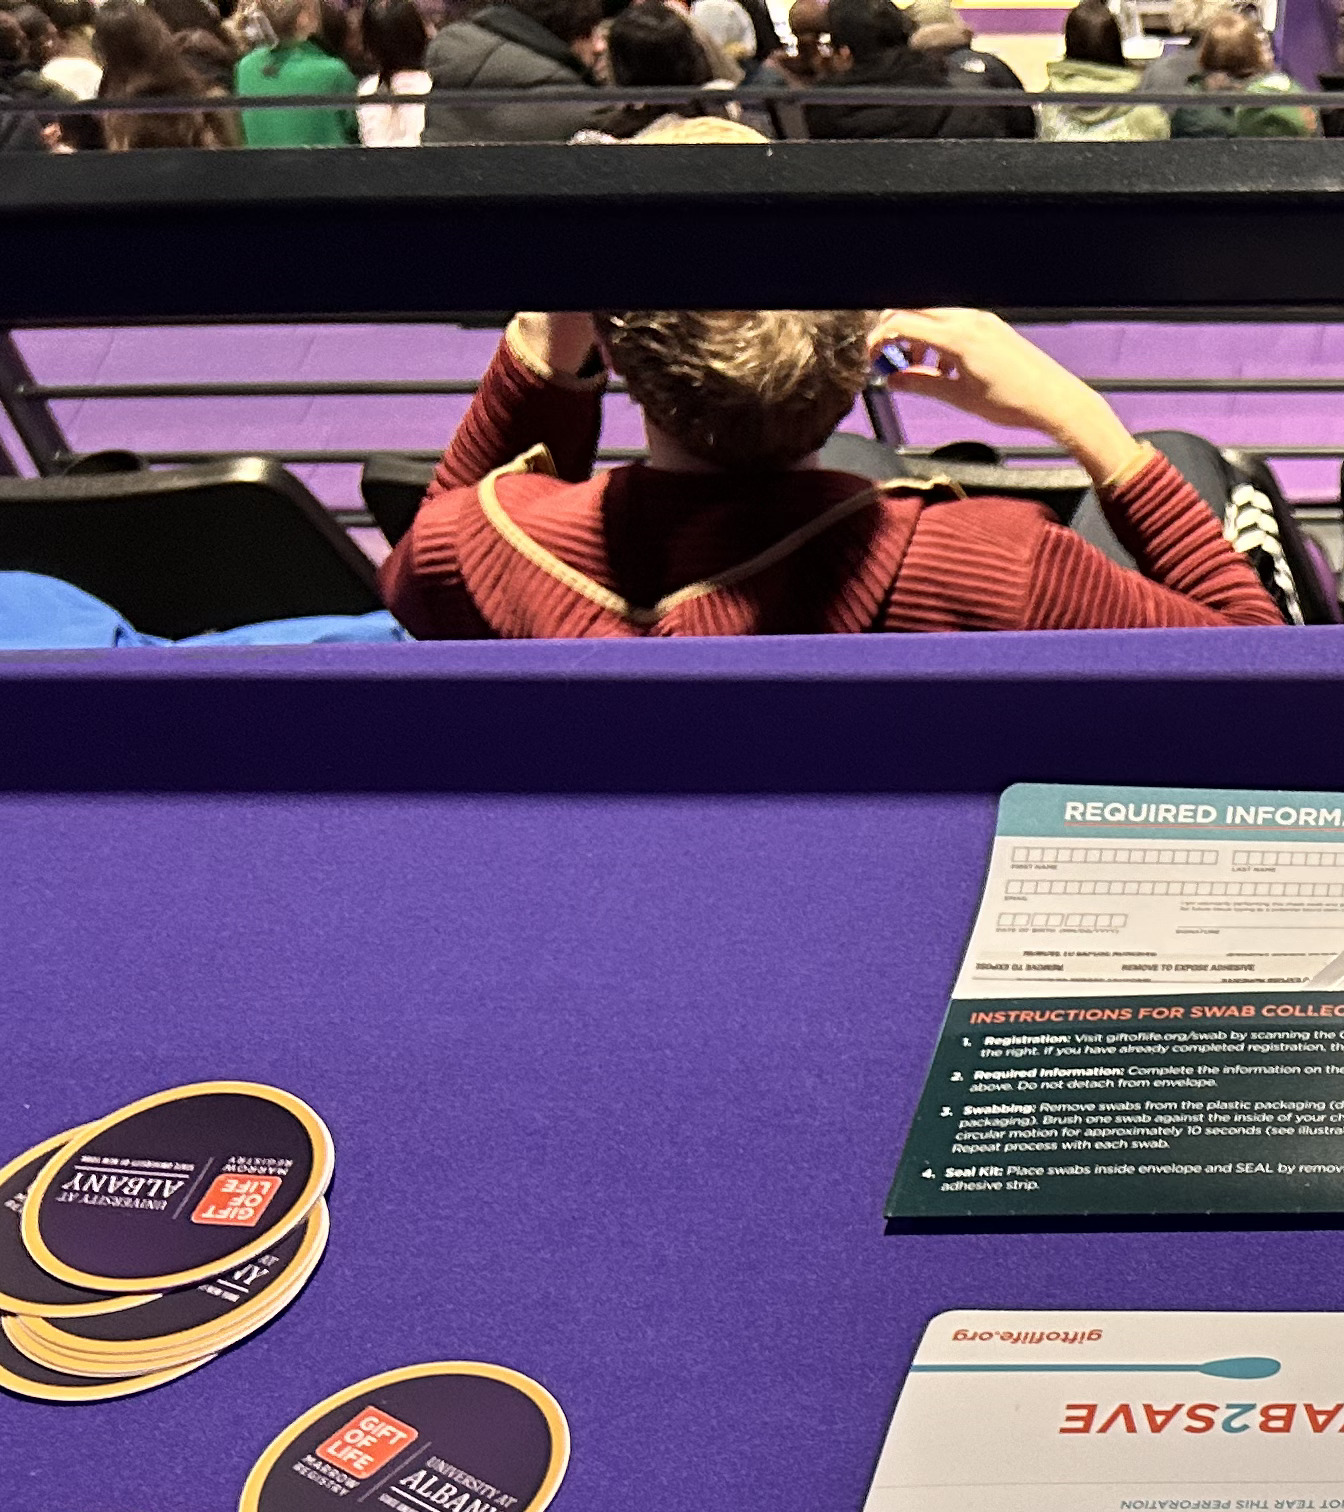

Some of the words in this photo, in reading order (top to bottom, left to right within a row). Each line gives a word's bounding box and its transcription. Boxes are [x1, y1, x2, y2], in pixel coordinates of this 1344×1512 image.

[1065, 802, 1217, 823] REQUIRED
[971, 1007, 1132, 1024] INSTRUCTIONS
[1138, 1007, 1185, 1021] FOR
[1190, 1006, 1255, 1018] SWAB
[1235, 1163, 1273, 1174] SEAL
[62, 1172, 186, 1198] ALBANY
[222, 1179, 272, 1193] LIFE
[202, 1205, 254, 1220] GIFT
[951, 1327, 1104, 1345] giftoflife.org
[344, 1429, 377, 1448] OF
[360, 1416, 408, 1445] GIFT
[326, 1440, 374, 1471] LIFE
[1120, 1500, 1232, 1510] PERFORATION
